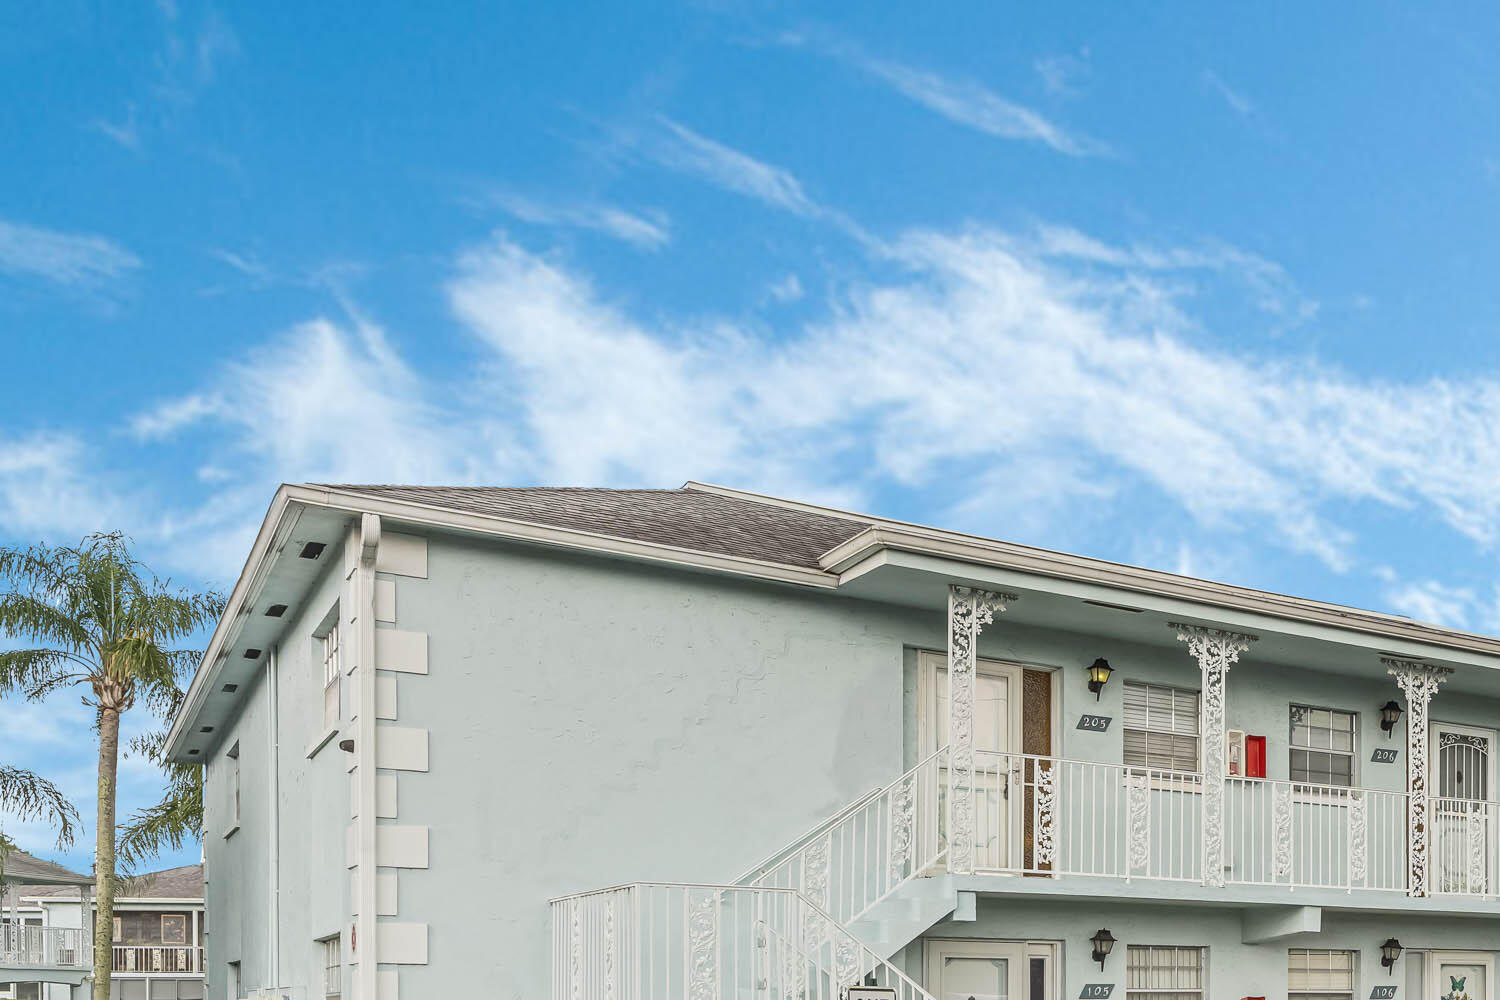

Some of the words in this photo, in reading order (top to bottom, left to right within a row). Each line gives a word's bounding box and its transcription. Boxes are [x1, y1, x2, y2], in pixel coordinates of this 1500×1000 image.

[1083, 717, 1106, 729] 205
[1376, 750, 1394, 762] 206
[1088, 986, 1109, 997] 105
[1376, 988, 1393, 998] 106
